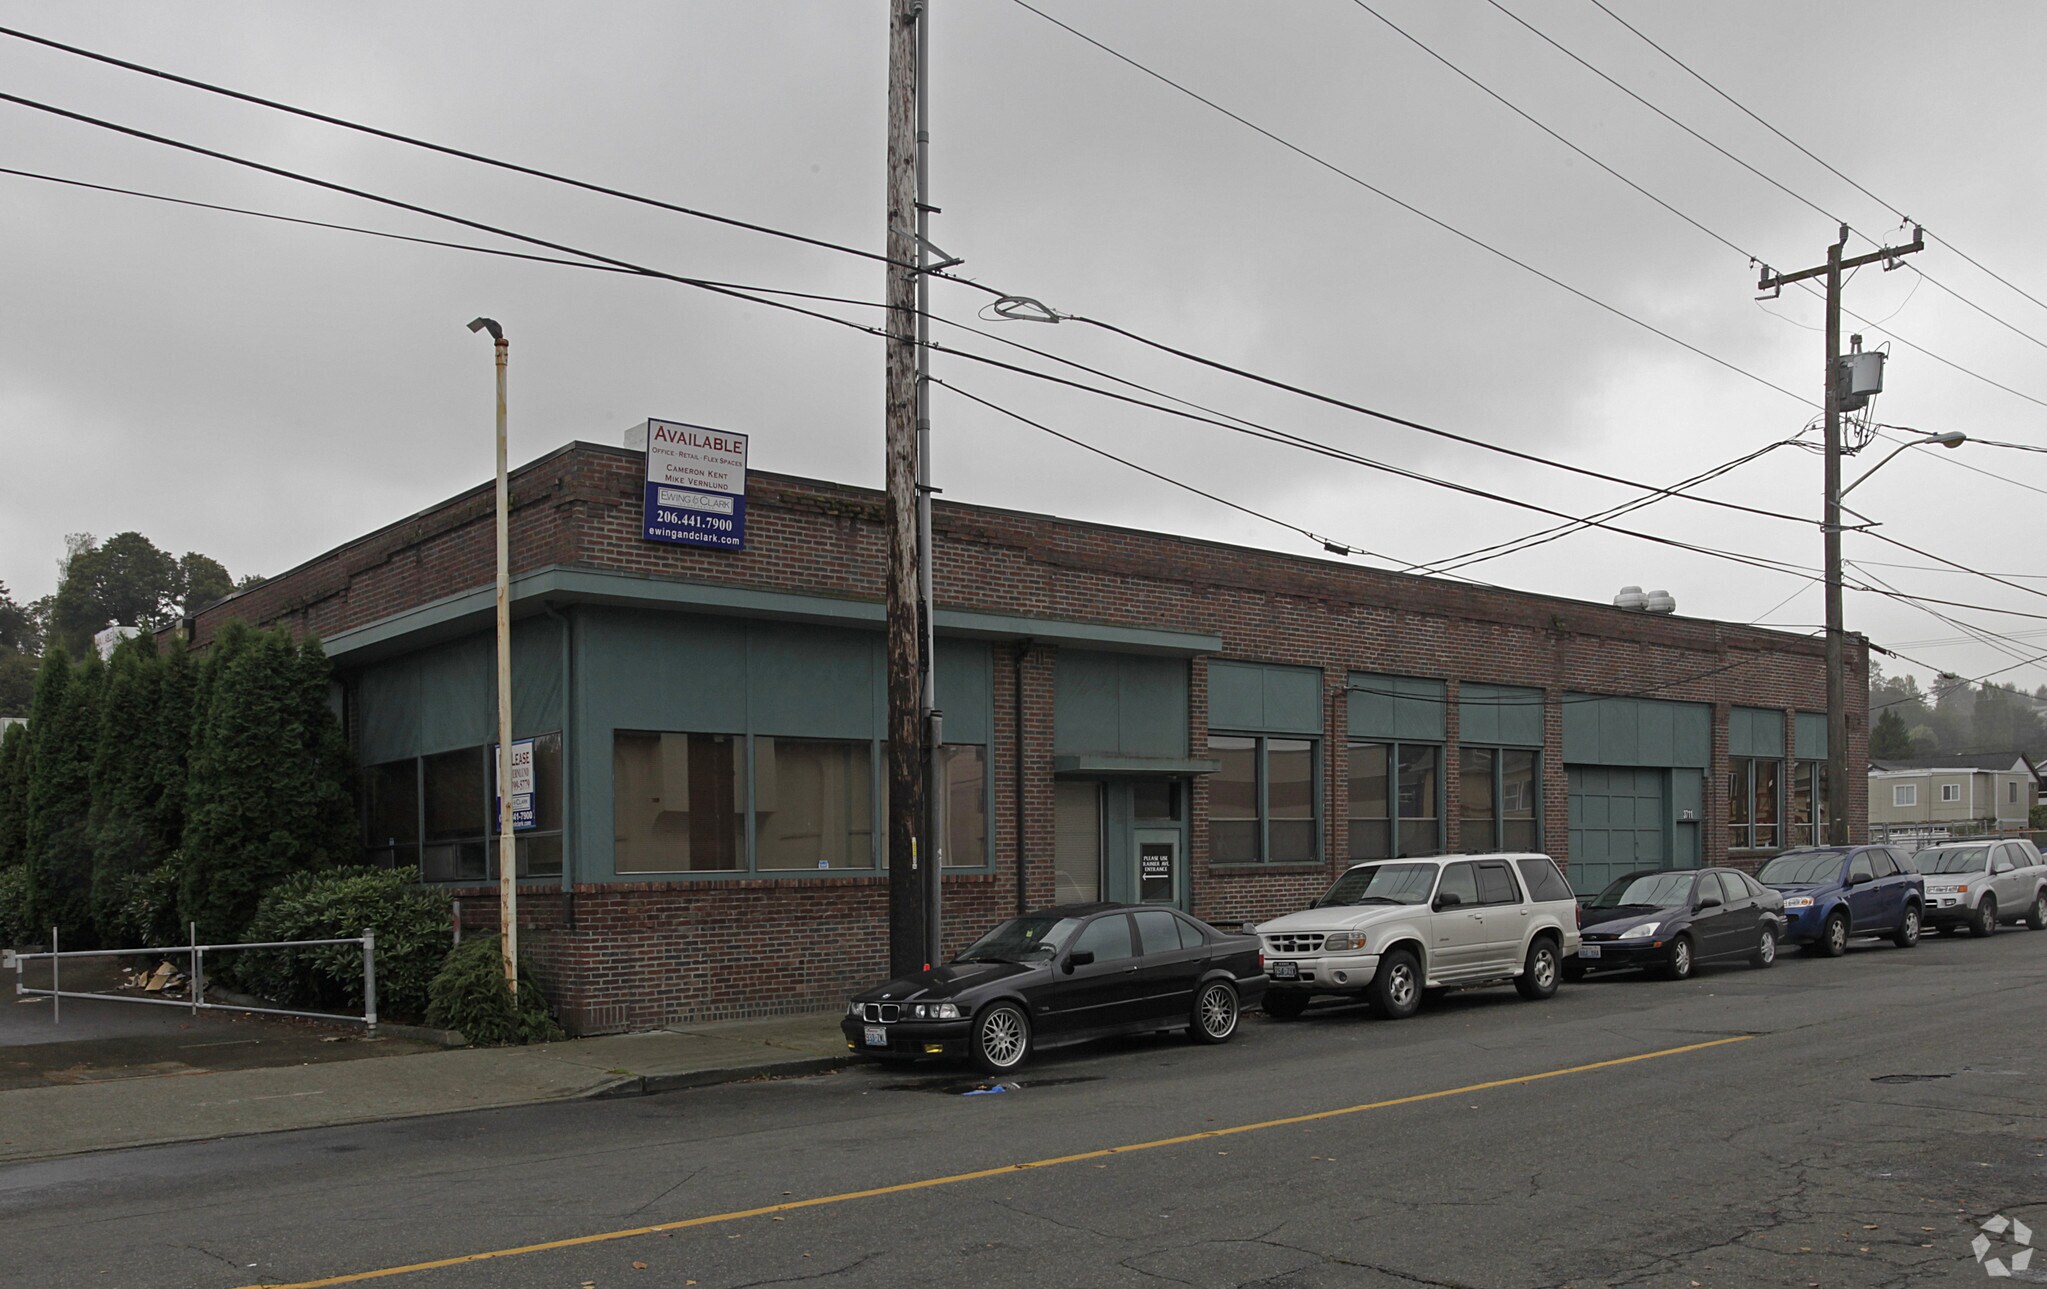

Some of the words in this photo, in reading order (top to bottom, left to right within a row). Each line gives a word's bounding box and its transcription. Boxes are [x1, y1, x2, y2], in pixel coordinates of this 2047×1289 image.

[654, 426, 743, 454] AVAILABLE
[652, 447, 675, 456] OFFICE
[679, 452, 699, 461] RETAIL
[703, 455, 718, 464] FLEX
[720, 458, 743, 467] SPACES
[666, 464, 705, 477] CAMERON
[708, 470, 728, 480] KENT
[665, 475, 685, 484] MIKE
[688, 478, 729, 491] VERNLUND
[661, 491, 691, 504] EWING
[699, 495, 730, 509] CLARK
[657, 510, 733, 531] 206.441.7900
[648, 527, 740, 545] ewingandclark.com
[511, 752, 530, 766] LEASE
[511, 768, 530, 779] ERNLUND
[513, 811, 532, 820] 41-7900
